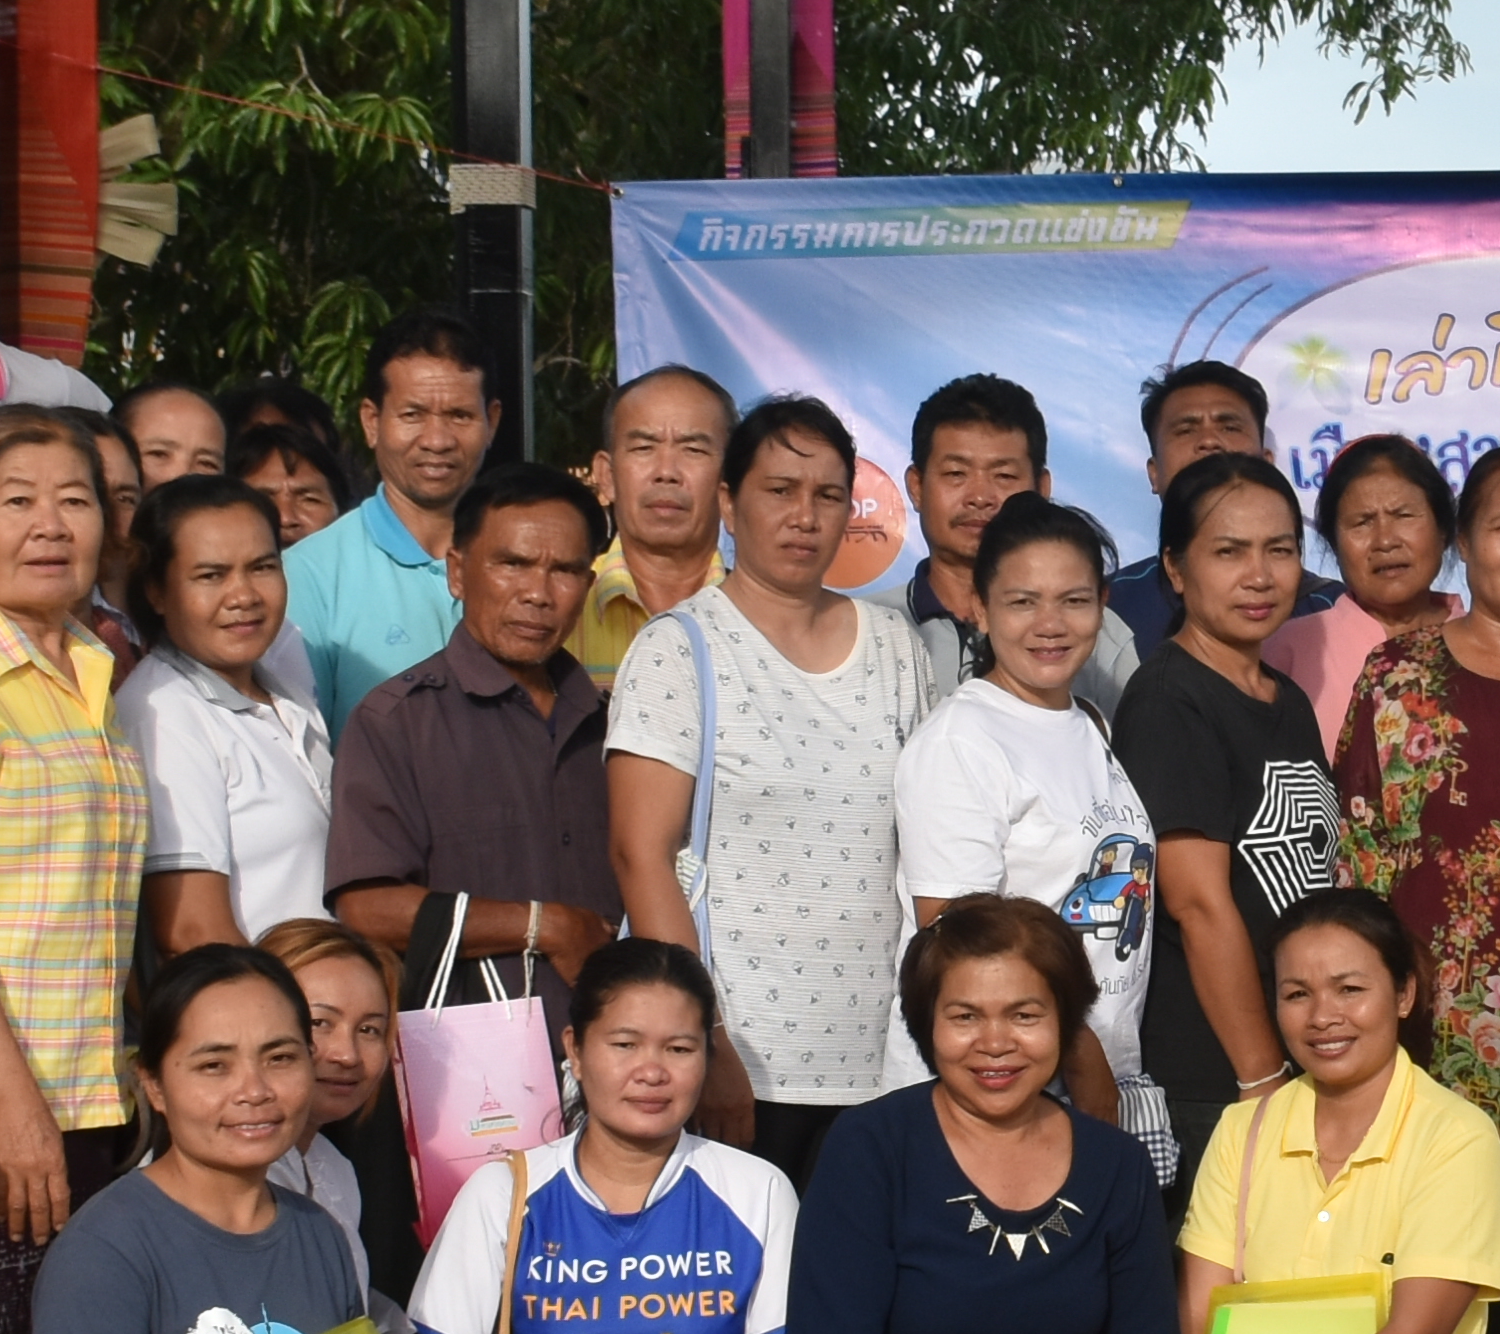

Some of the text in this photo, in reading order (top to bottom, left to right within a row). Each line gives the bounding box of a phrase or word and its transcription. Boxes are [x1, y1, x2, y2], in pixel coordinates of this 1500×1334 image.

[699, 204, 1160, 252] กิจกรรมการประกวดแข่งขัน
[527, 1250, 733, 1284] KING POWER
[522, 1290, 736, 1321] THAI POWER
